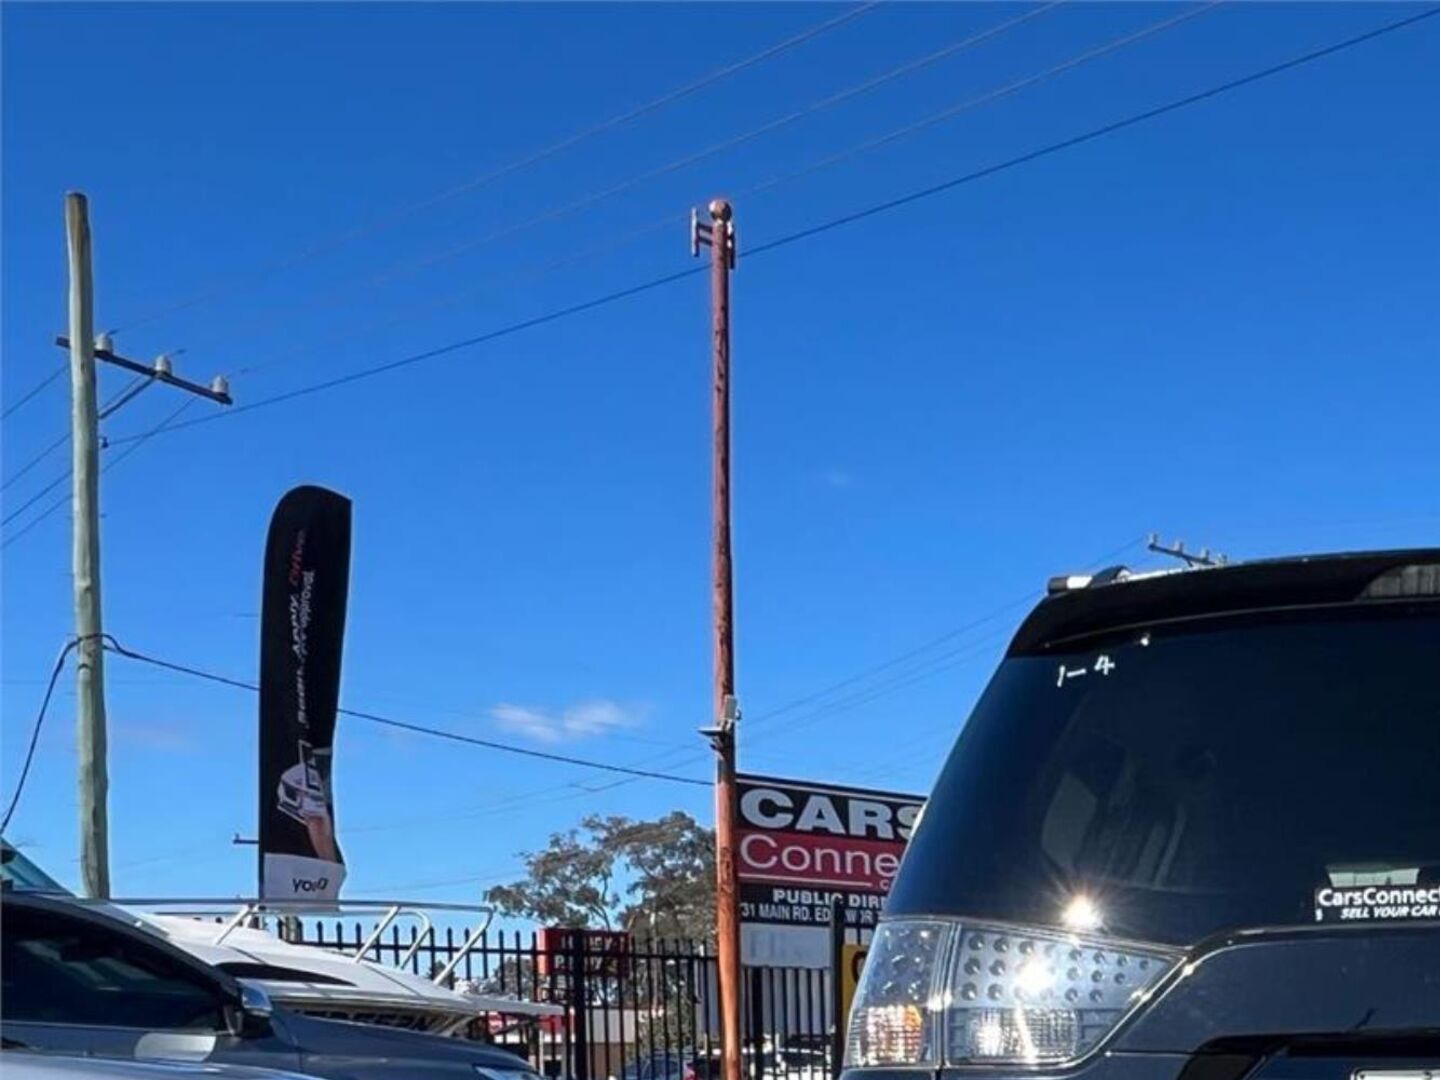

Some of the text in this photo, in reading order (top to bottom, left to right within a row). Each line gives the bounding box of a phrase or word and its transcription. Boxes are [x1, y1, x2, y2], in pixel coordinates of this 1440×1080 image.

[758, 904, 790, 919] MAIN
[1341, 907, 1371, 919] SELL
[1373, 905, 1410, 918] YOUR
[1410, 905, 1439, 917] CAR
